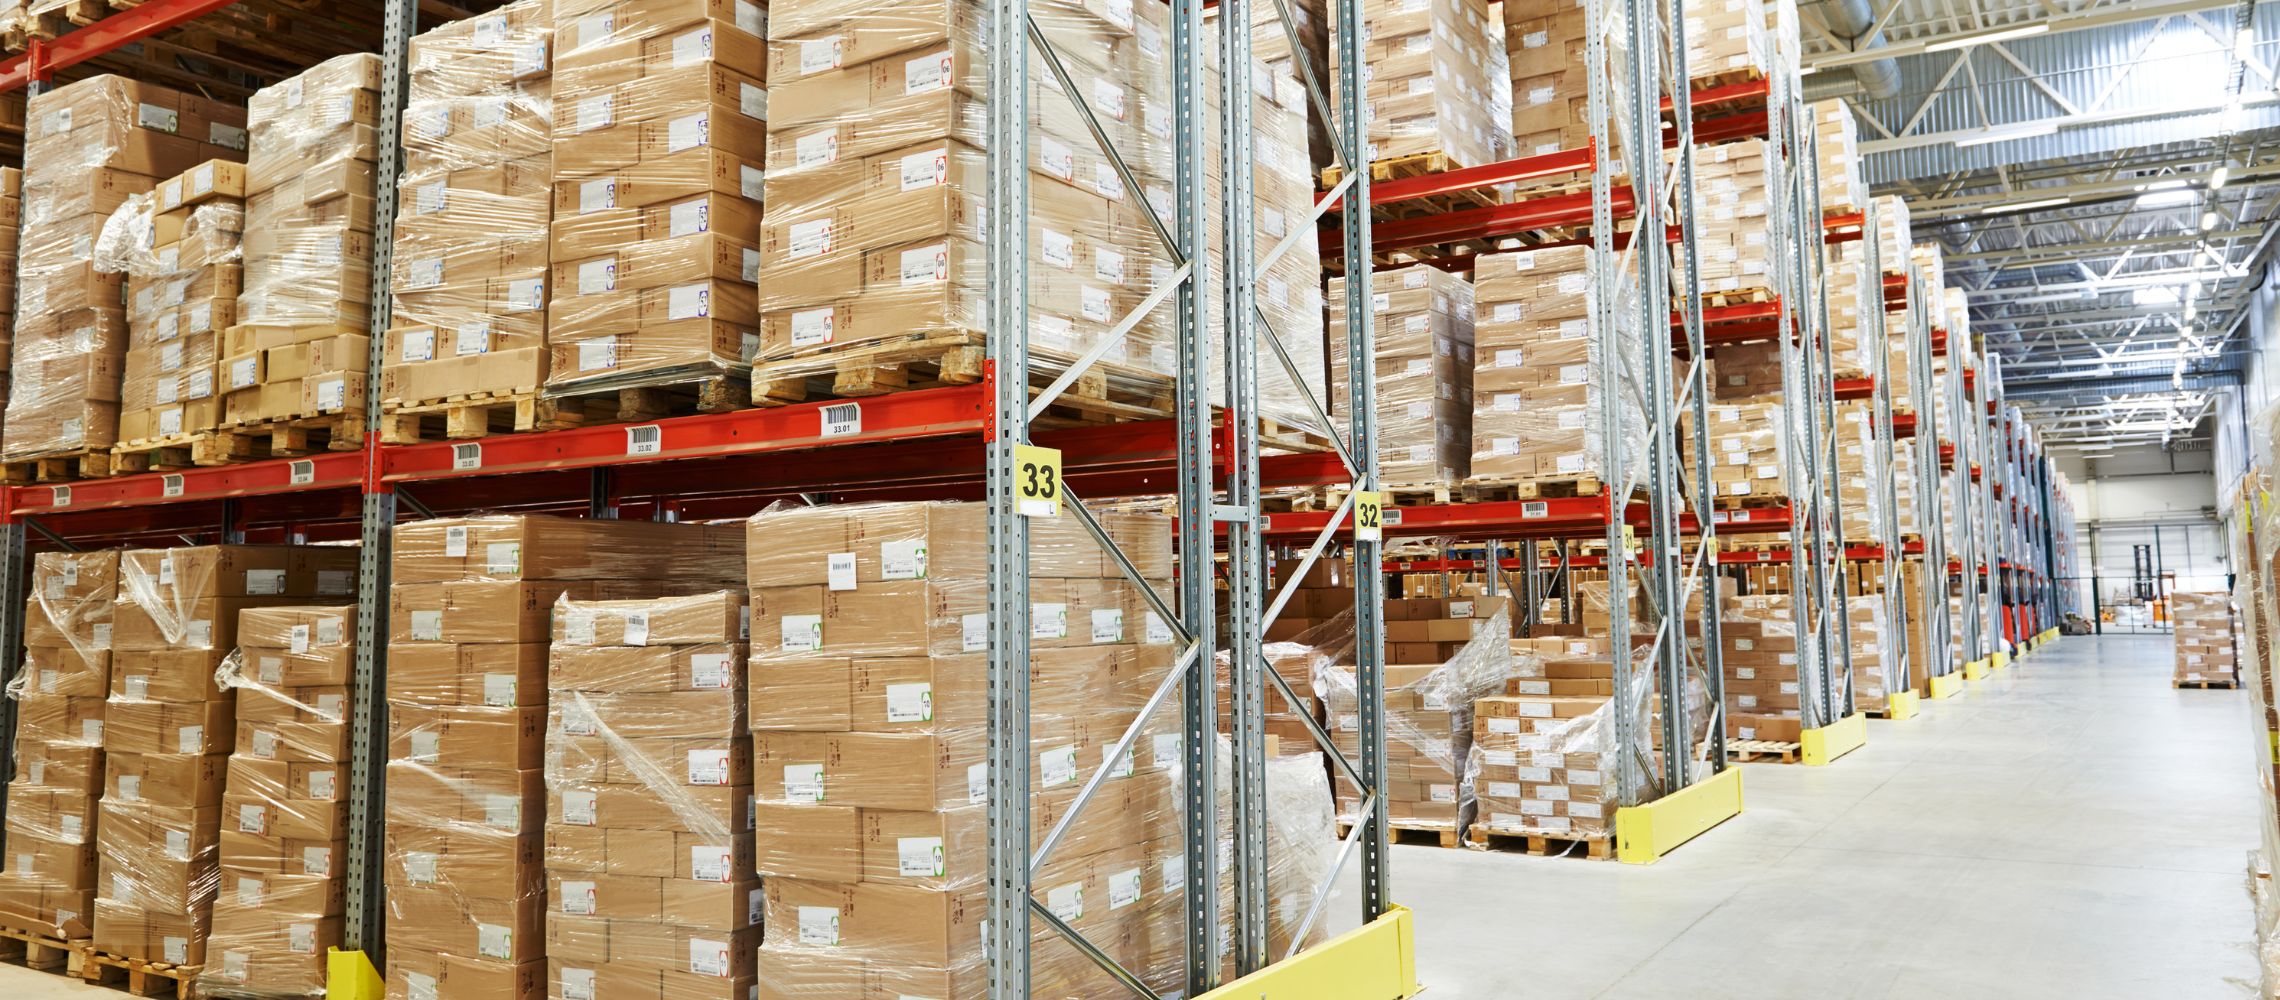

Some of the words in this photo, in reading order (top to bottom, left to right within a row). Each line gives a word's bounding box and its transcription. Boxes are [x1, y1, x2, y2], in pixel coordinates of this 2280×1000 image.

[834, 425, 850, 433] 33.01
[638, 444, 652, 452] 33.02
[1023, 463, 1055, 498] 33
[1360, 503, 1378, 527] 32
[1625, 533, 1632, 549] 31
